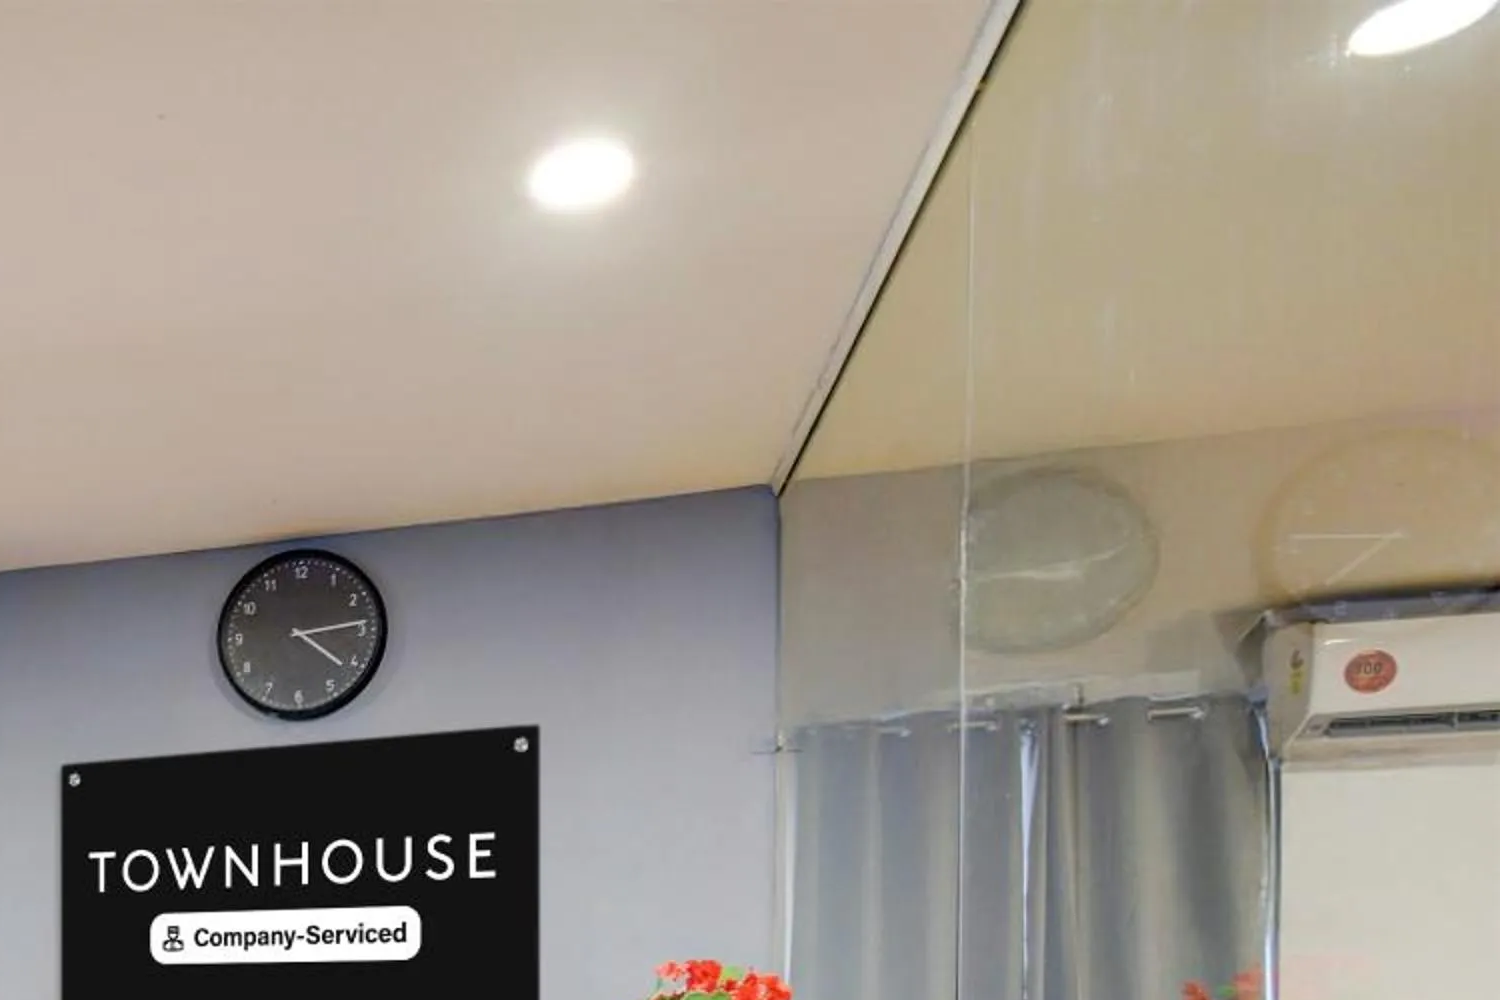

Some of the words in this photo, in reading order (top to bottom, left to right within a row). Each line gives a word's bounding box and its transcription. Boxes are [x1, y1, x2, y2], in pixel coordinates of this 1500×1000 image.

[294, 567, 308, 579] 12
[331, 573, 337, 586] 1
[264, 579, 277, 591] 11
[349, 593, 357, 607] 2
[243, 602, 256, 615] 10
[357, 622, 366, 637] 3
[235, 633, 243, 646] 9
[243, 661, 251, 673] 8
[350, 655, 359, 667] 4
[265, 681, 274, 693] 7
[325, 679, 335, 692] 5
[293, 690, 303, 704] 6
[88, 831, 497, 893] TOWNHOUSE
[193, 921, 407, 950] Company-Serviced
